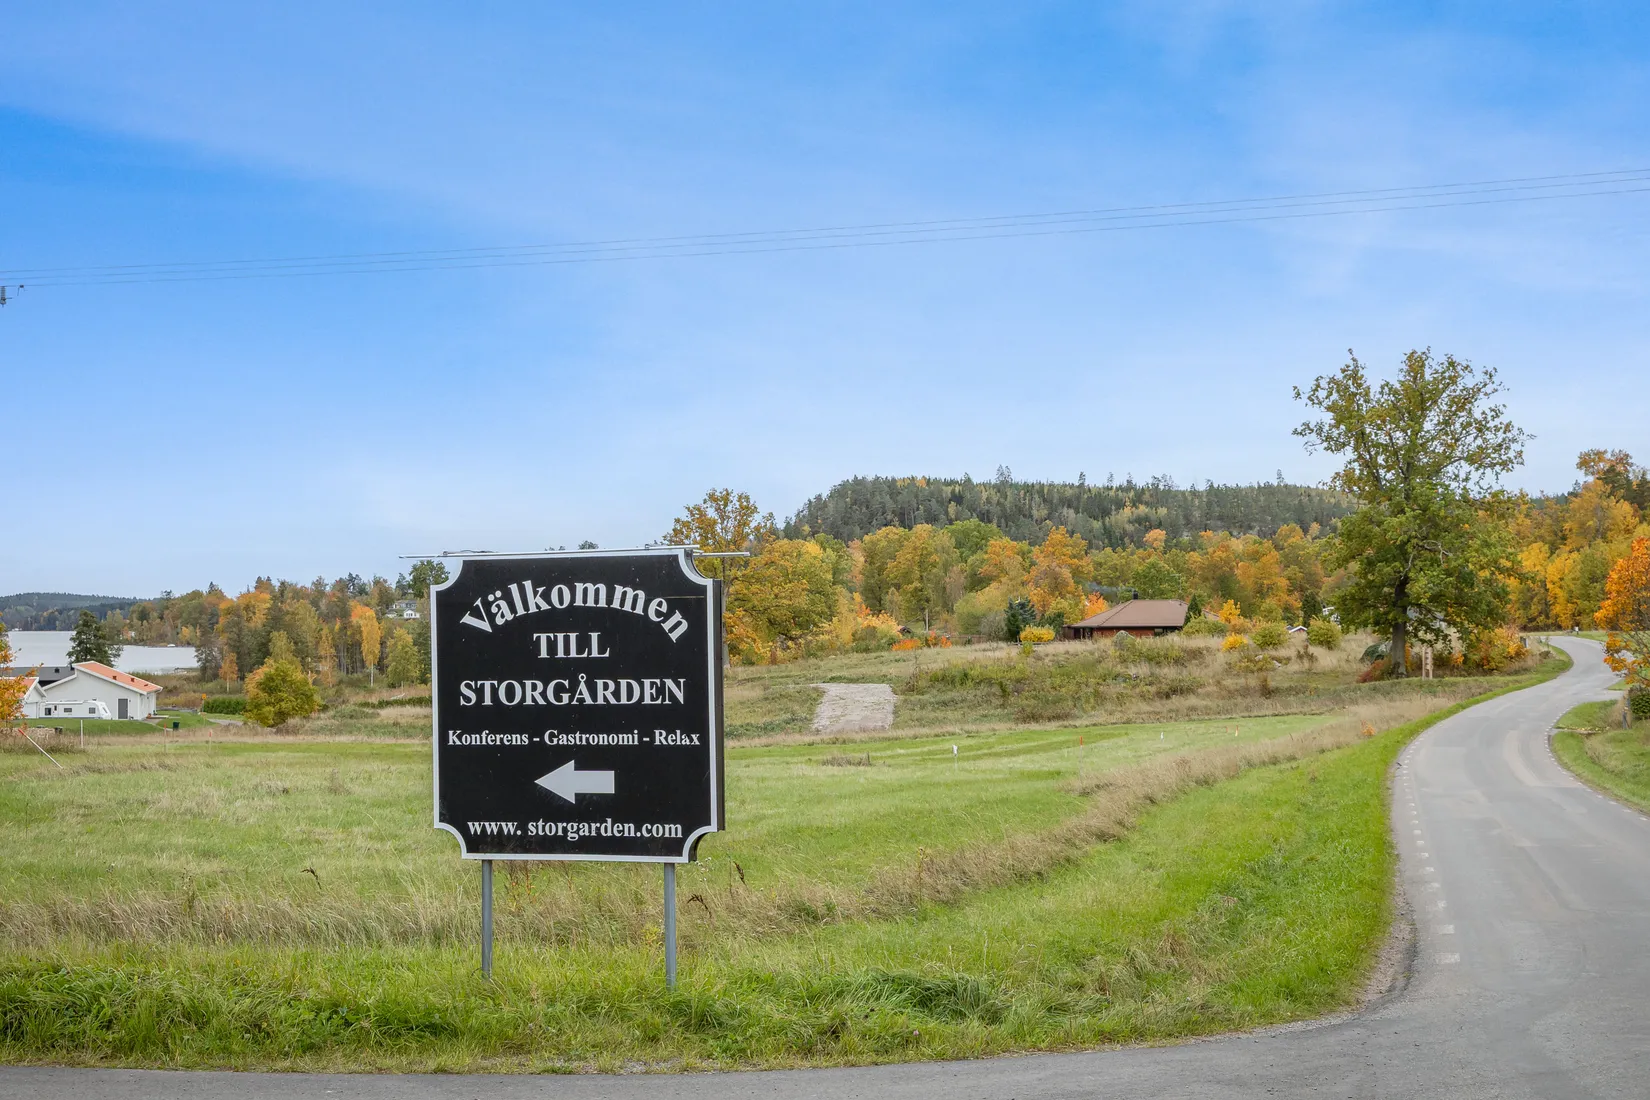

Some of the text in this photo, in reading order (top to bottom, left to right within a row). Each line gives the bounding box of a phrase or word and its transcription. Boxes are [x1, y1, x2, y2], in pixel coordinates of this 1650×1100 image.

[459, 579, 689, 643] Välkommen
[533, 631, 610, 659] TILL
[459, 673, 687, 706] STORGÅRDEN
[447, 729, 529, 746] Konferens
[543, 729, 639, 746] Gastronomi
[653, 729, 701, 746] Relax
